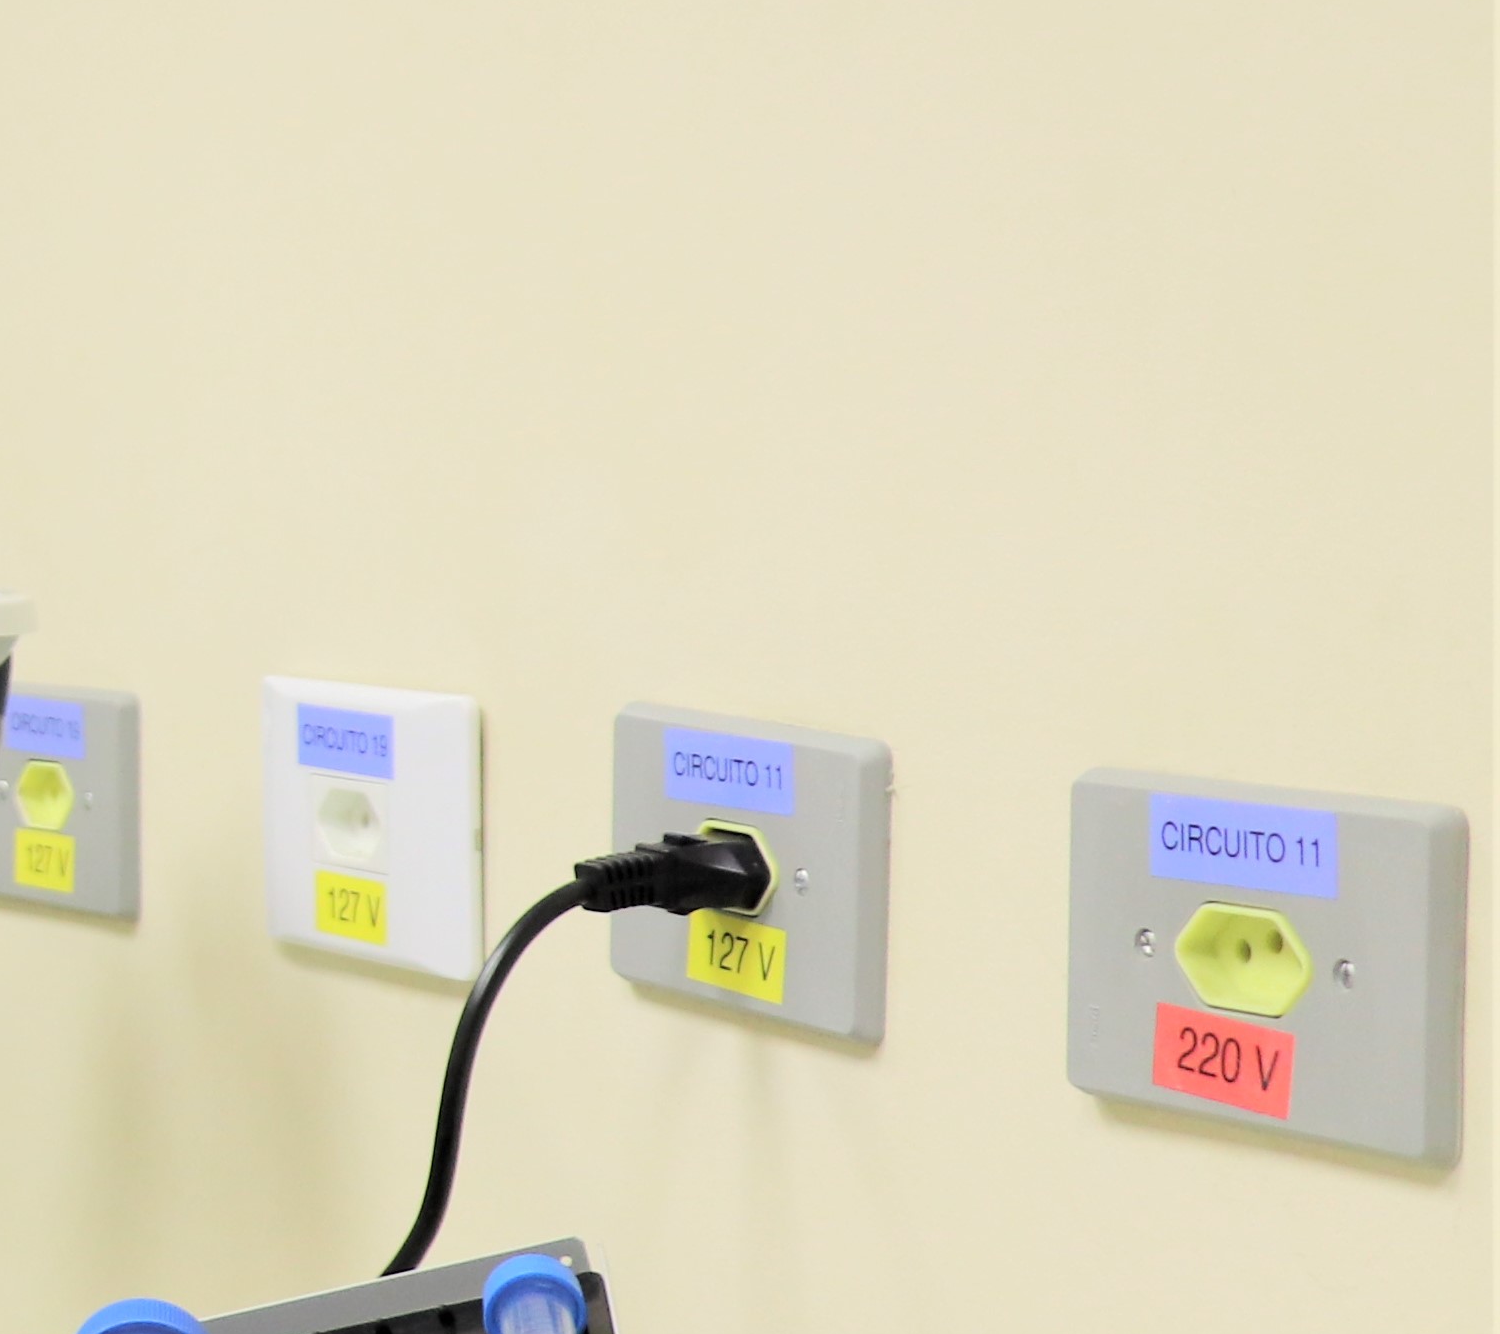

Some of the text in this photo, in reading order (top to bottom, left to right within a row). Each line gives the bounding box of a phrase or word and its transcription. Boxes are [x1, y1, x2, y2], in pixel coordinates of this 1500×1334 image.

[303, 723, 388, 757] CIRCUITO 19
[673, 751, 782, 790] CIRCUITO 11
[27, 843, 71, 878] 127 V
[1161, 821, 1320, 867] CIRCUITO 11
[328, 887, 381, 928] 127 V
[707, 929, 776, 982] 127 V
[1177, 1026, 1279, 1092] 220 V
